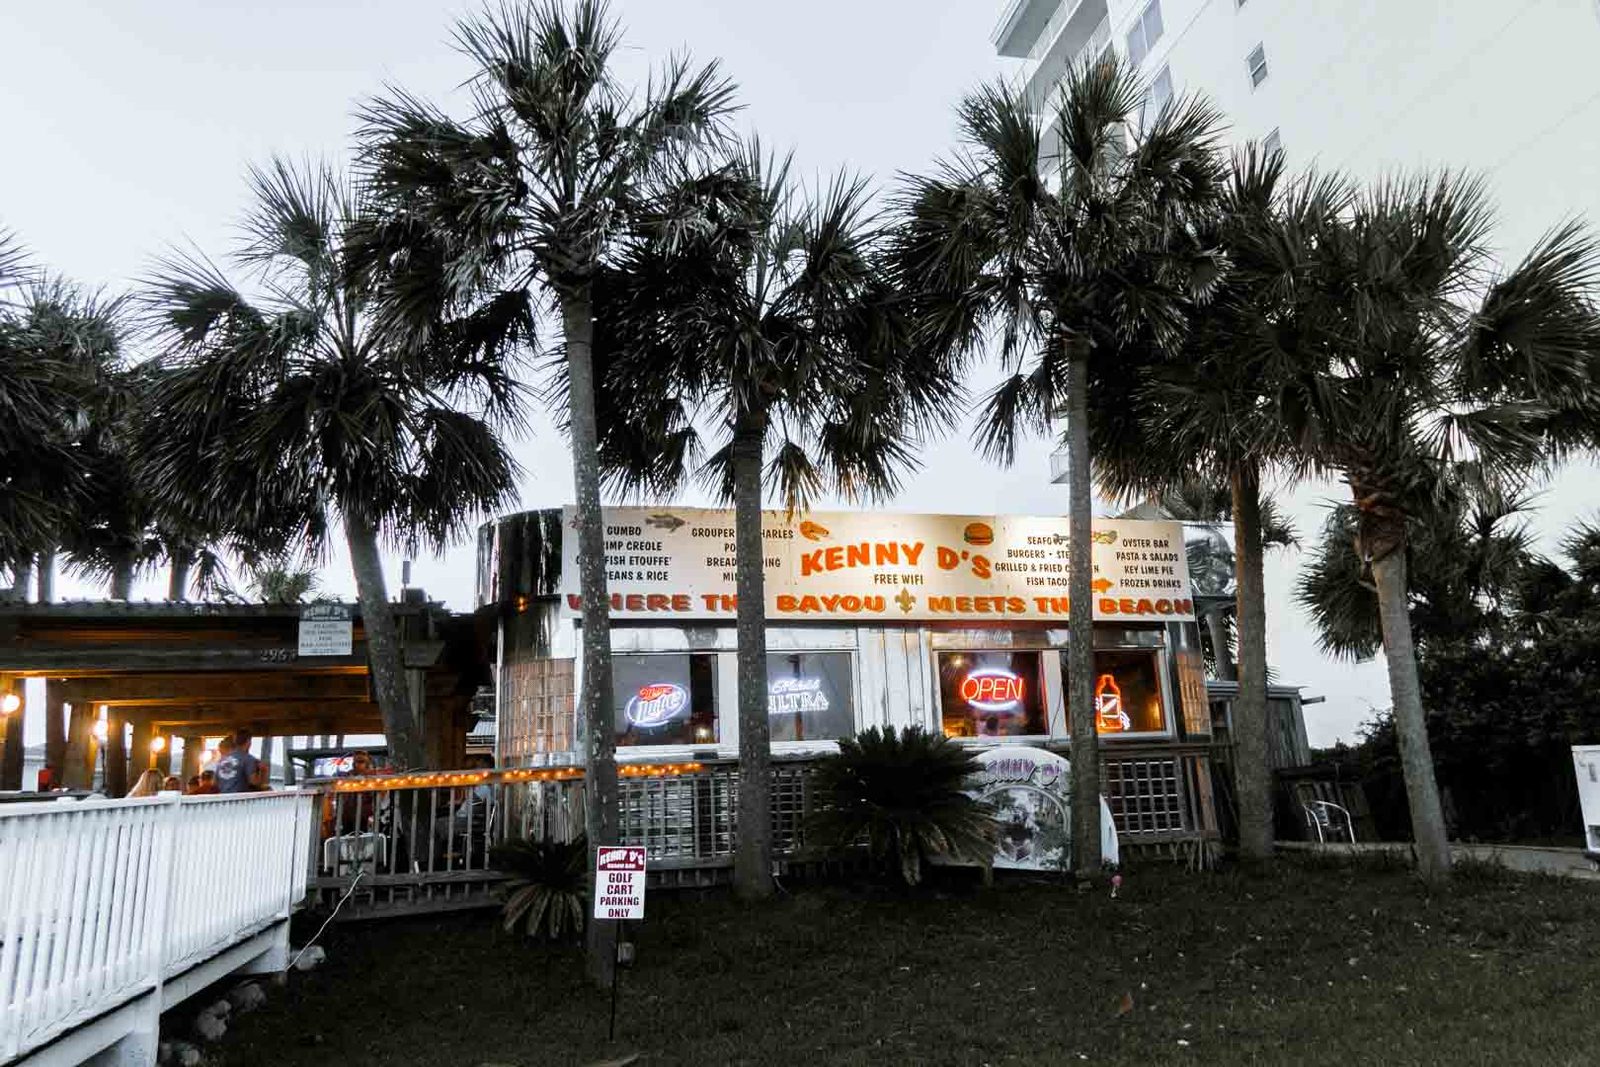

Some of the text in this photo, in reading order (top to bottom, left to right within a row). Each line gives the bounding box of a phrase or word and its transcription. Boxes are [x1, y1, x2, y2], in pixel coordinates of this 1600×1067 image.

[606, 525, 642, 536] GUMBO
[691, 528, 794, 539] GROUPER HARLES
[626, 541, 663, 551] CREOLE
[1122, 538, 1169, 548] OYSTER BAR
[1007, 549, 1046, 559] BURGERS
[1116, 552, 1140, 561] PASTA
[1149, 553, 1179, 562] SALADS
[800, 541, 992, 579] KENNY D'S
[995, 562, 1028, 572] GRILLED
[1030, 564, 1037, 572] &
[1039, 563, 1063, 573] FRIED
[1124, 565, 1174, 576] KEY LIME PIE
[604, 571, 669, 581] EANS & RICE
[873, 574, 924, 585] FREE WIFI
[1026, 577, 1045, 586] FISH
[1120, 579, 1182, 588] FROZEN DRINKS
[701, 594, 738, 612] TH
[776, 594, 887, 613] BAYOU
[928, 596, 1027, 614] MEETS
[1032, 597, 1070, 614] TH
[1098, 598, 1194, 615] BEACH
[961, 677, 1024, 701] OPEN
[608, 872, 633, 883] GOLF
[606, 884, 634, 895] CART
[600, 896, 640, 906] PARKING
[608, 908, 630, 917] ONLY
